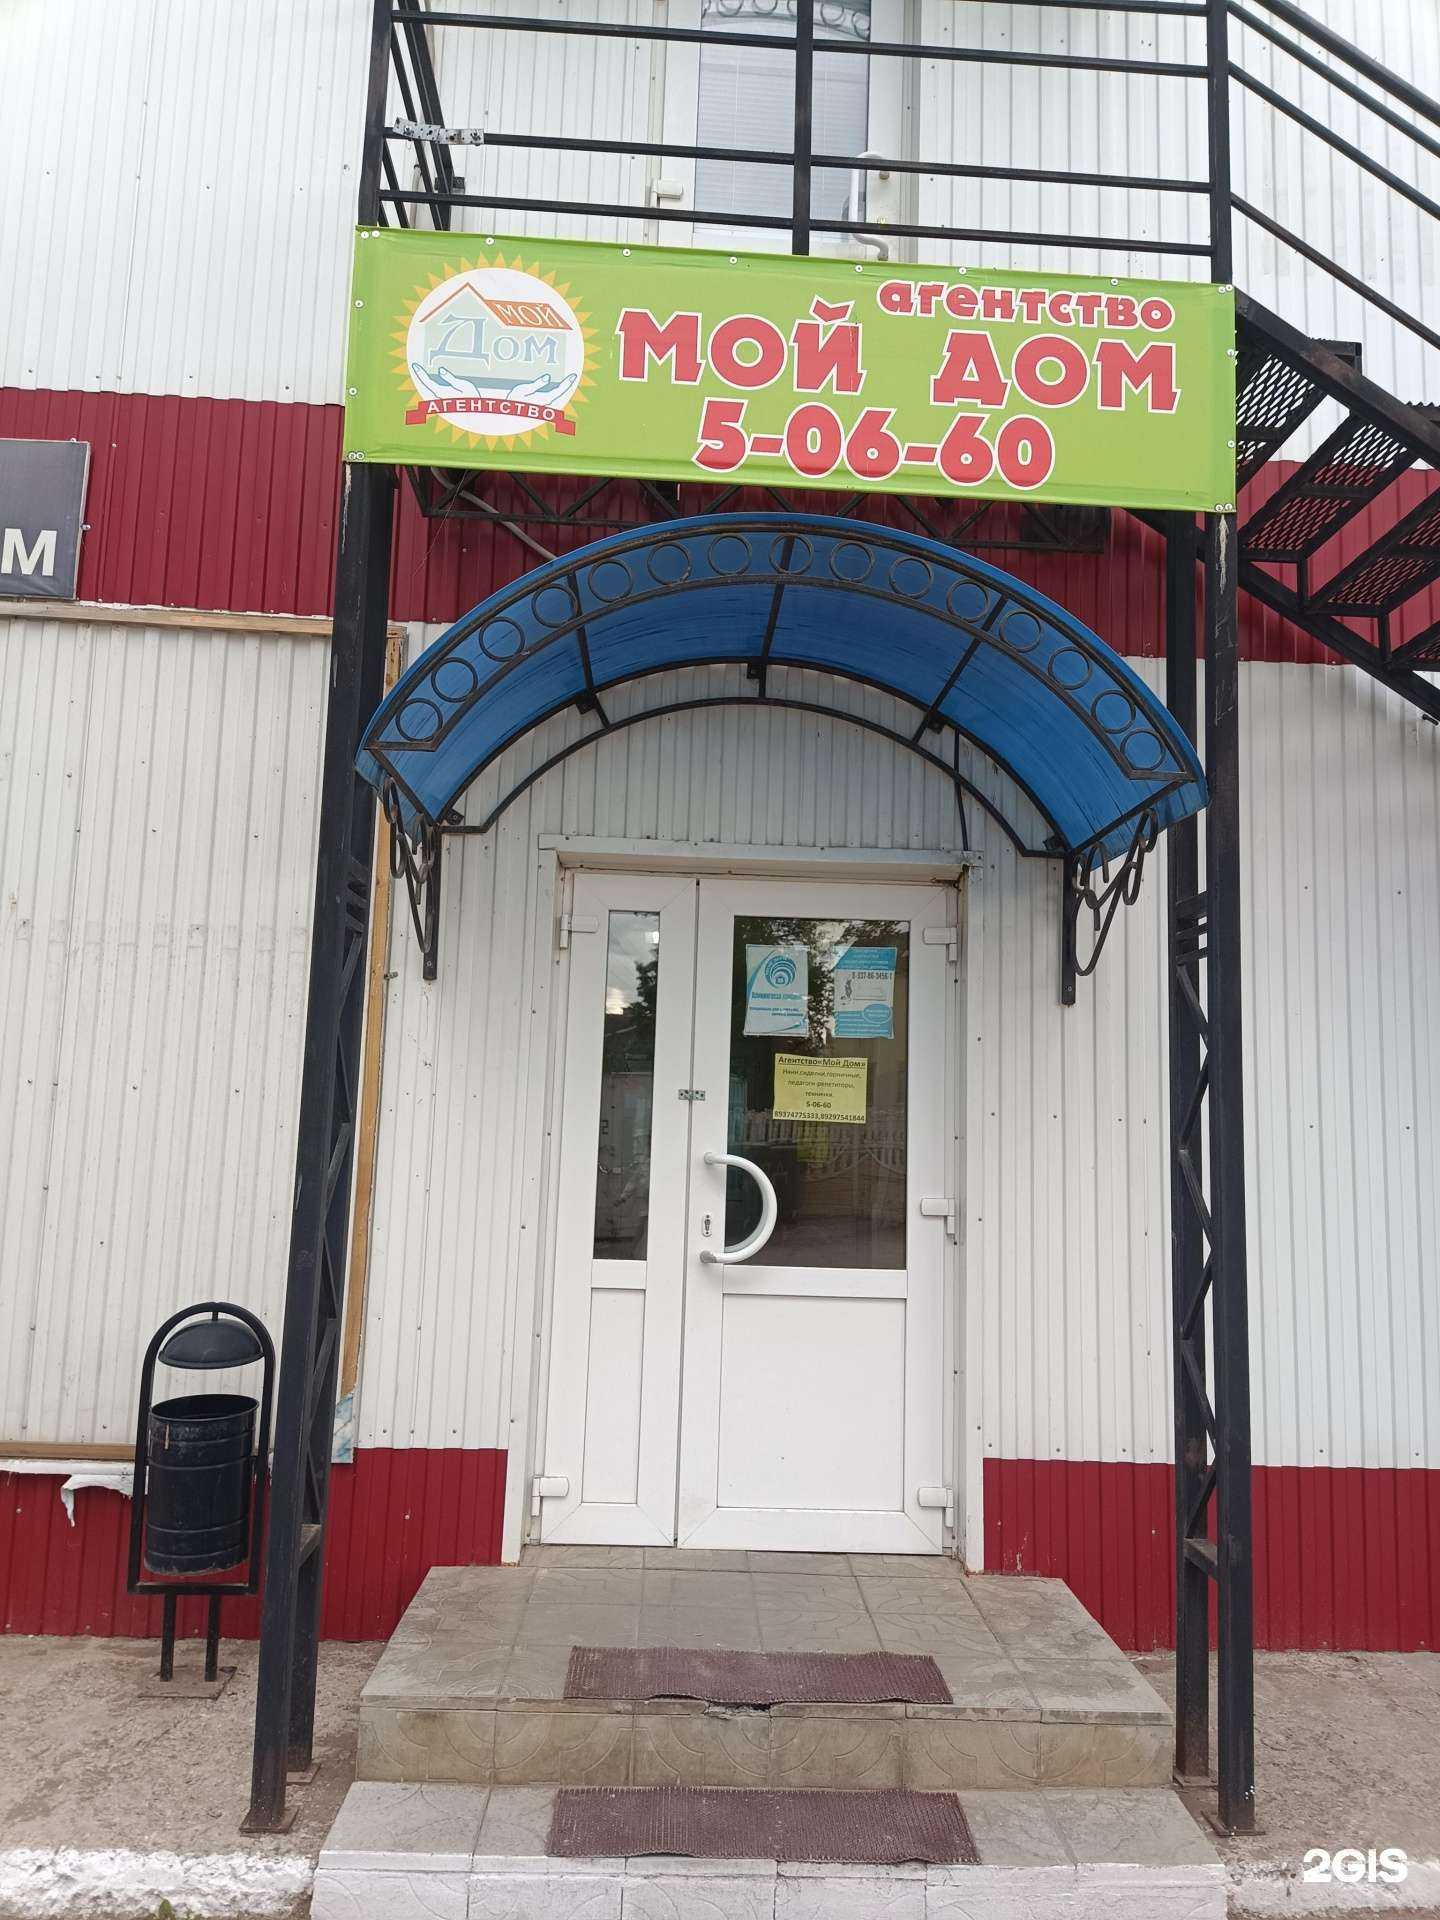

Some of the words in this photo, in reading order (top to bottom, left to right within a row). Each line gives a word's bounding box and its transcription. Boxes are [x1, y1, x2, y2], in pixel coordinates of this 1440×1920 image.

[496, 302, 562, 328] МОЙ
[878, 280, 1175, 332] агентство
[615, 295, 867, 395] МОЙ
[930, 329, 1181, 413] ДОМ
[427, 399, 556, 421] АГЕНТСТВО
[691, 397, 1055, 490] 5-06-60
[806, 1101, 832, 1109] 5-06-60
